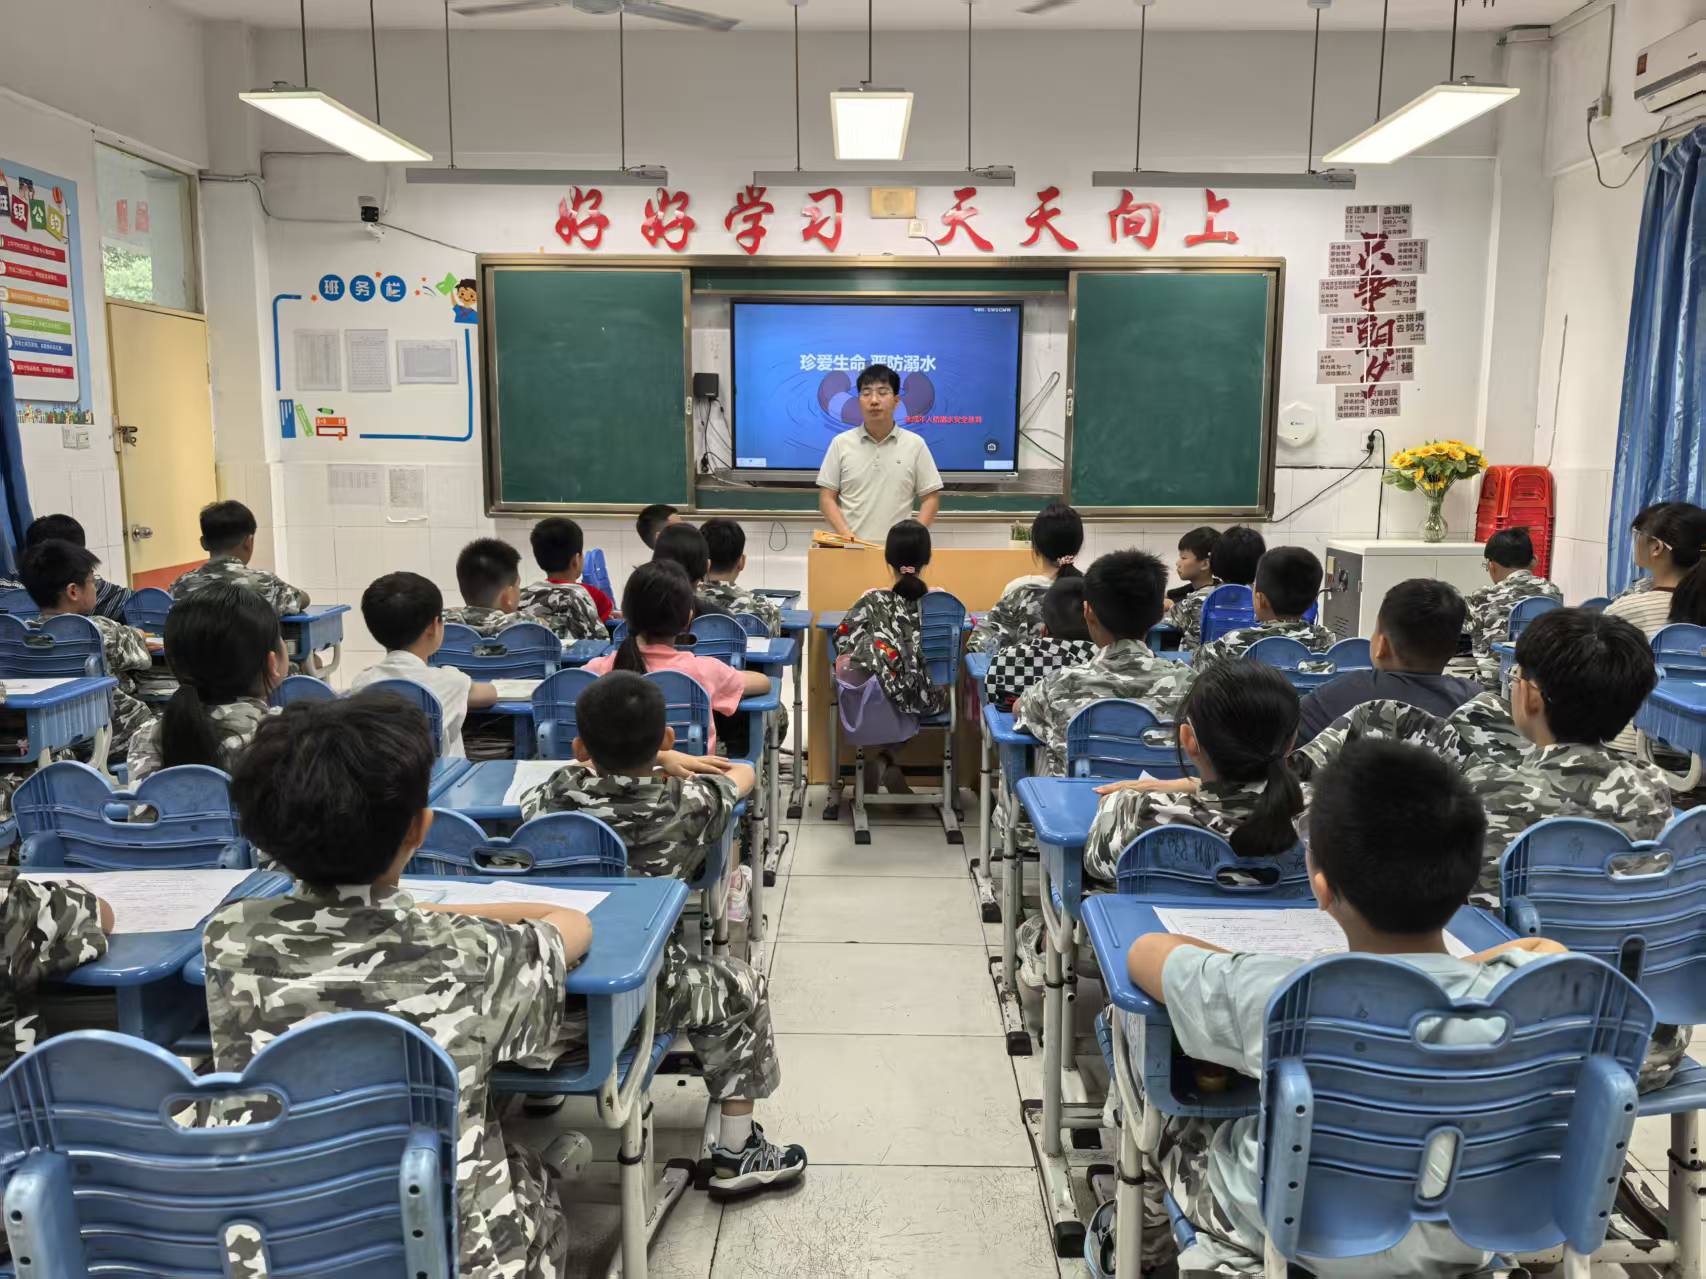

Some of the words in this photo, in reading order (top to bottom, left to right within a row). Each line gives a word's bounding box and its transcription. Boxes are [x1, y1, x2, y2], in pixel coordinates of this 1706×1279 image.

[555, 184, 844, 256] 好好学习
[934, 186, 1240, 251] 天天向上
[324, 279, 401, 297] 班务栏
[1396, 312, 1425, 323] 去拼搏
[1395, 322, 1425, 333] 去努力
[799, 353, 866, 372] 珍爱生命
[870, 353, 937, 372] 严防溺水
